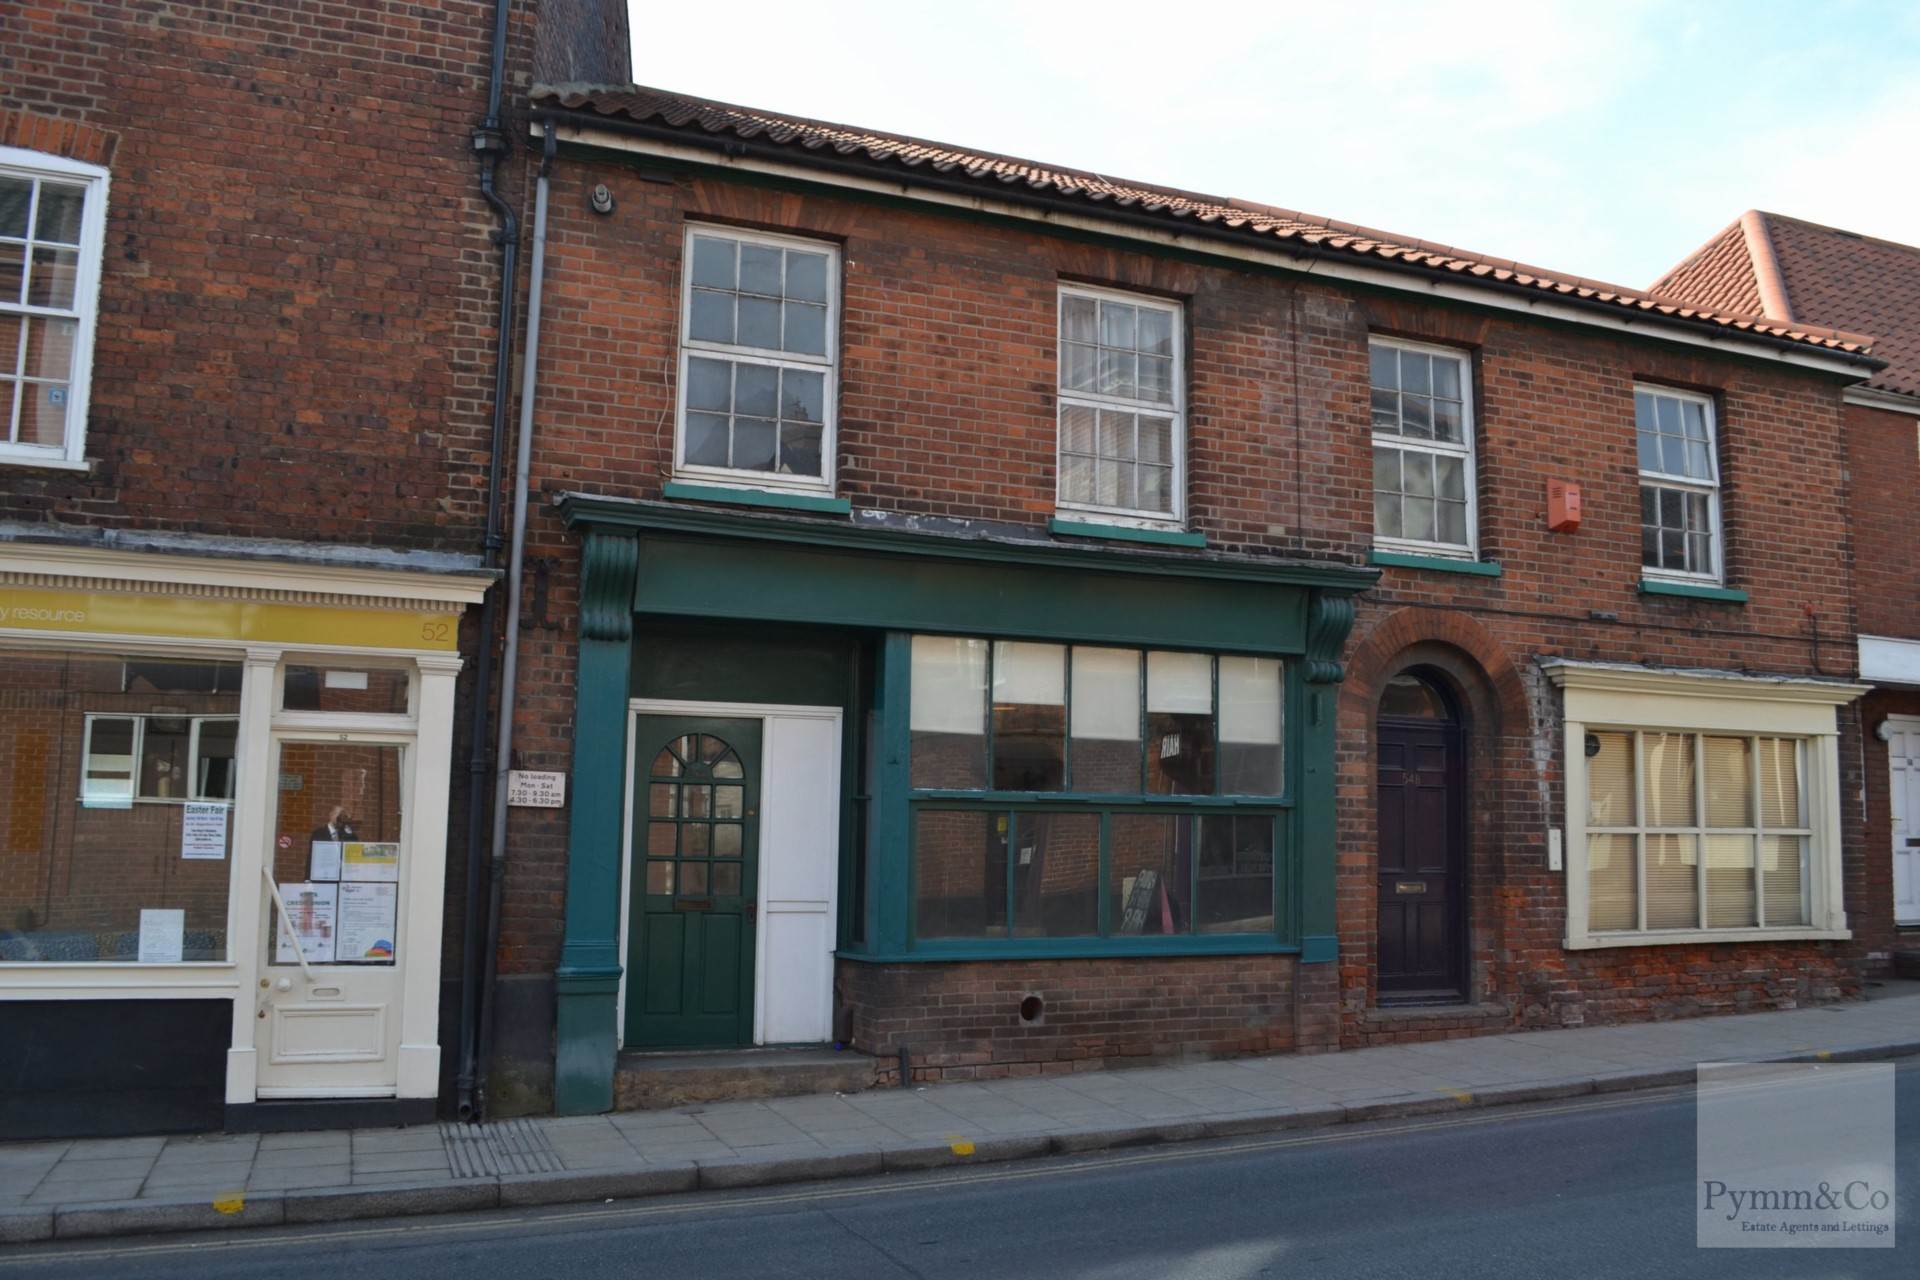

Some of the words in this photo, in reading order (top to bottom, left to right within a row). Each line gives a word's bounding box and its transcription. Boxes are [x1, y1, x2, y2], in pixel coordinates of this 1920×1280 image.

[12, 607, 86, 623] resource
[421, 622, 449, 642] 52
[530, 773, 556, 781] loading
[186, 804, 208, 815] Easter
[210, 805, 225, 815] Fair
